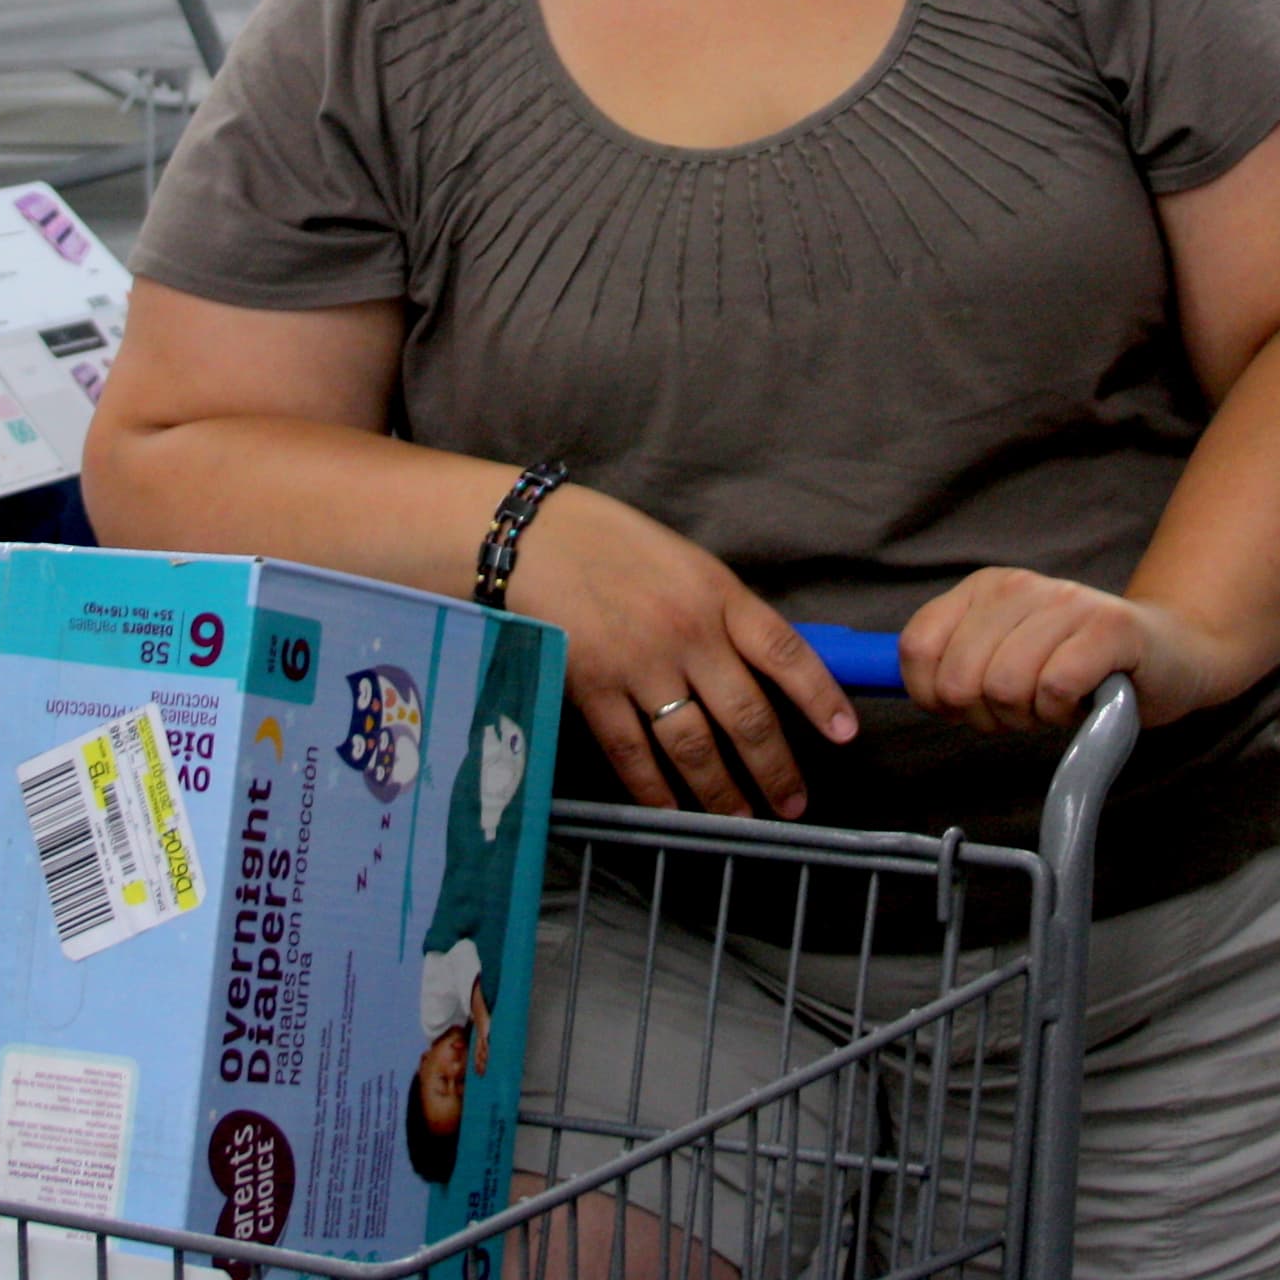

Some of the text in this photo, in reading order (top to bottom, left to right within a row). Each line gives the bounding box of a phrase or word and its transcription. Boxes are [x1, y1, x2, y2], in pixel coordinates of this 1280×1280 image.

[131, 606, 150, 620] lbs
[190, 612, 225, 668] 6
[140, 640, 172, 665] 58
[266, 633, 280, 674] size
[281, 636, 311, 682] 6
[151, 689, 220, 709] Nocturna
[292, 744, 319, 903] Protección
[162, 825, 193, 896] D6704
[286, 911, 303, 964] con
[247, 848, 292, 1084] Diapers
[289, 951, 314, 1086] Nocturna
[229, 1122, 255, 1264] arent's
[257, 1136, 276, 1234] CHOICE
